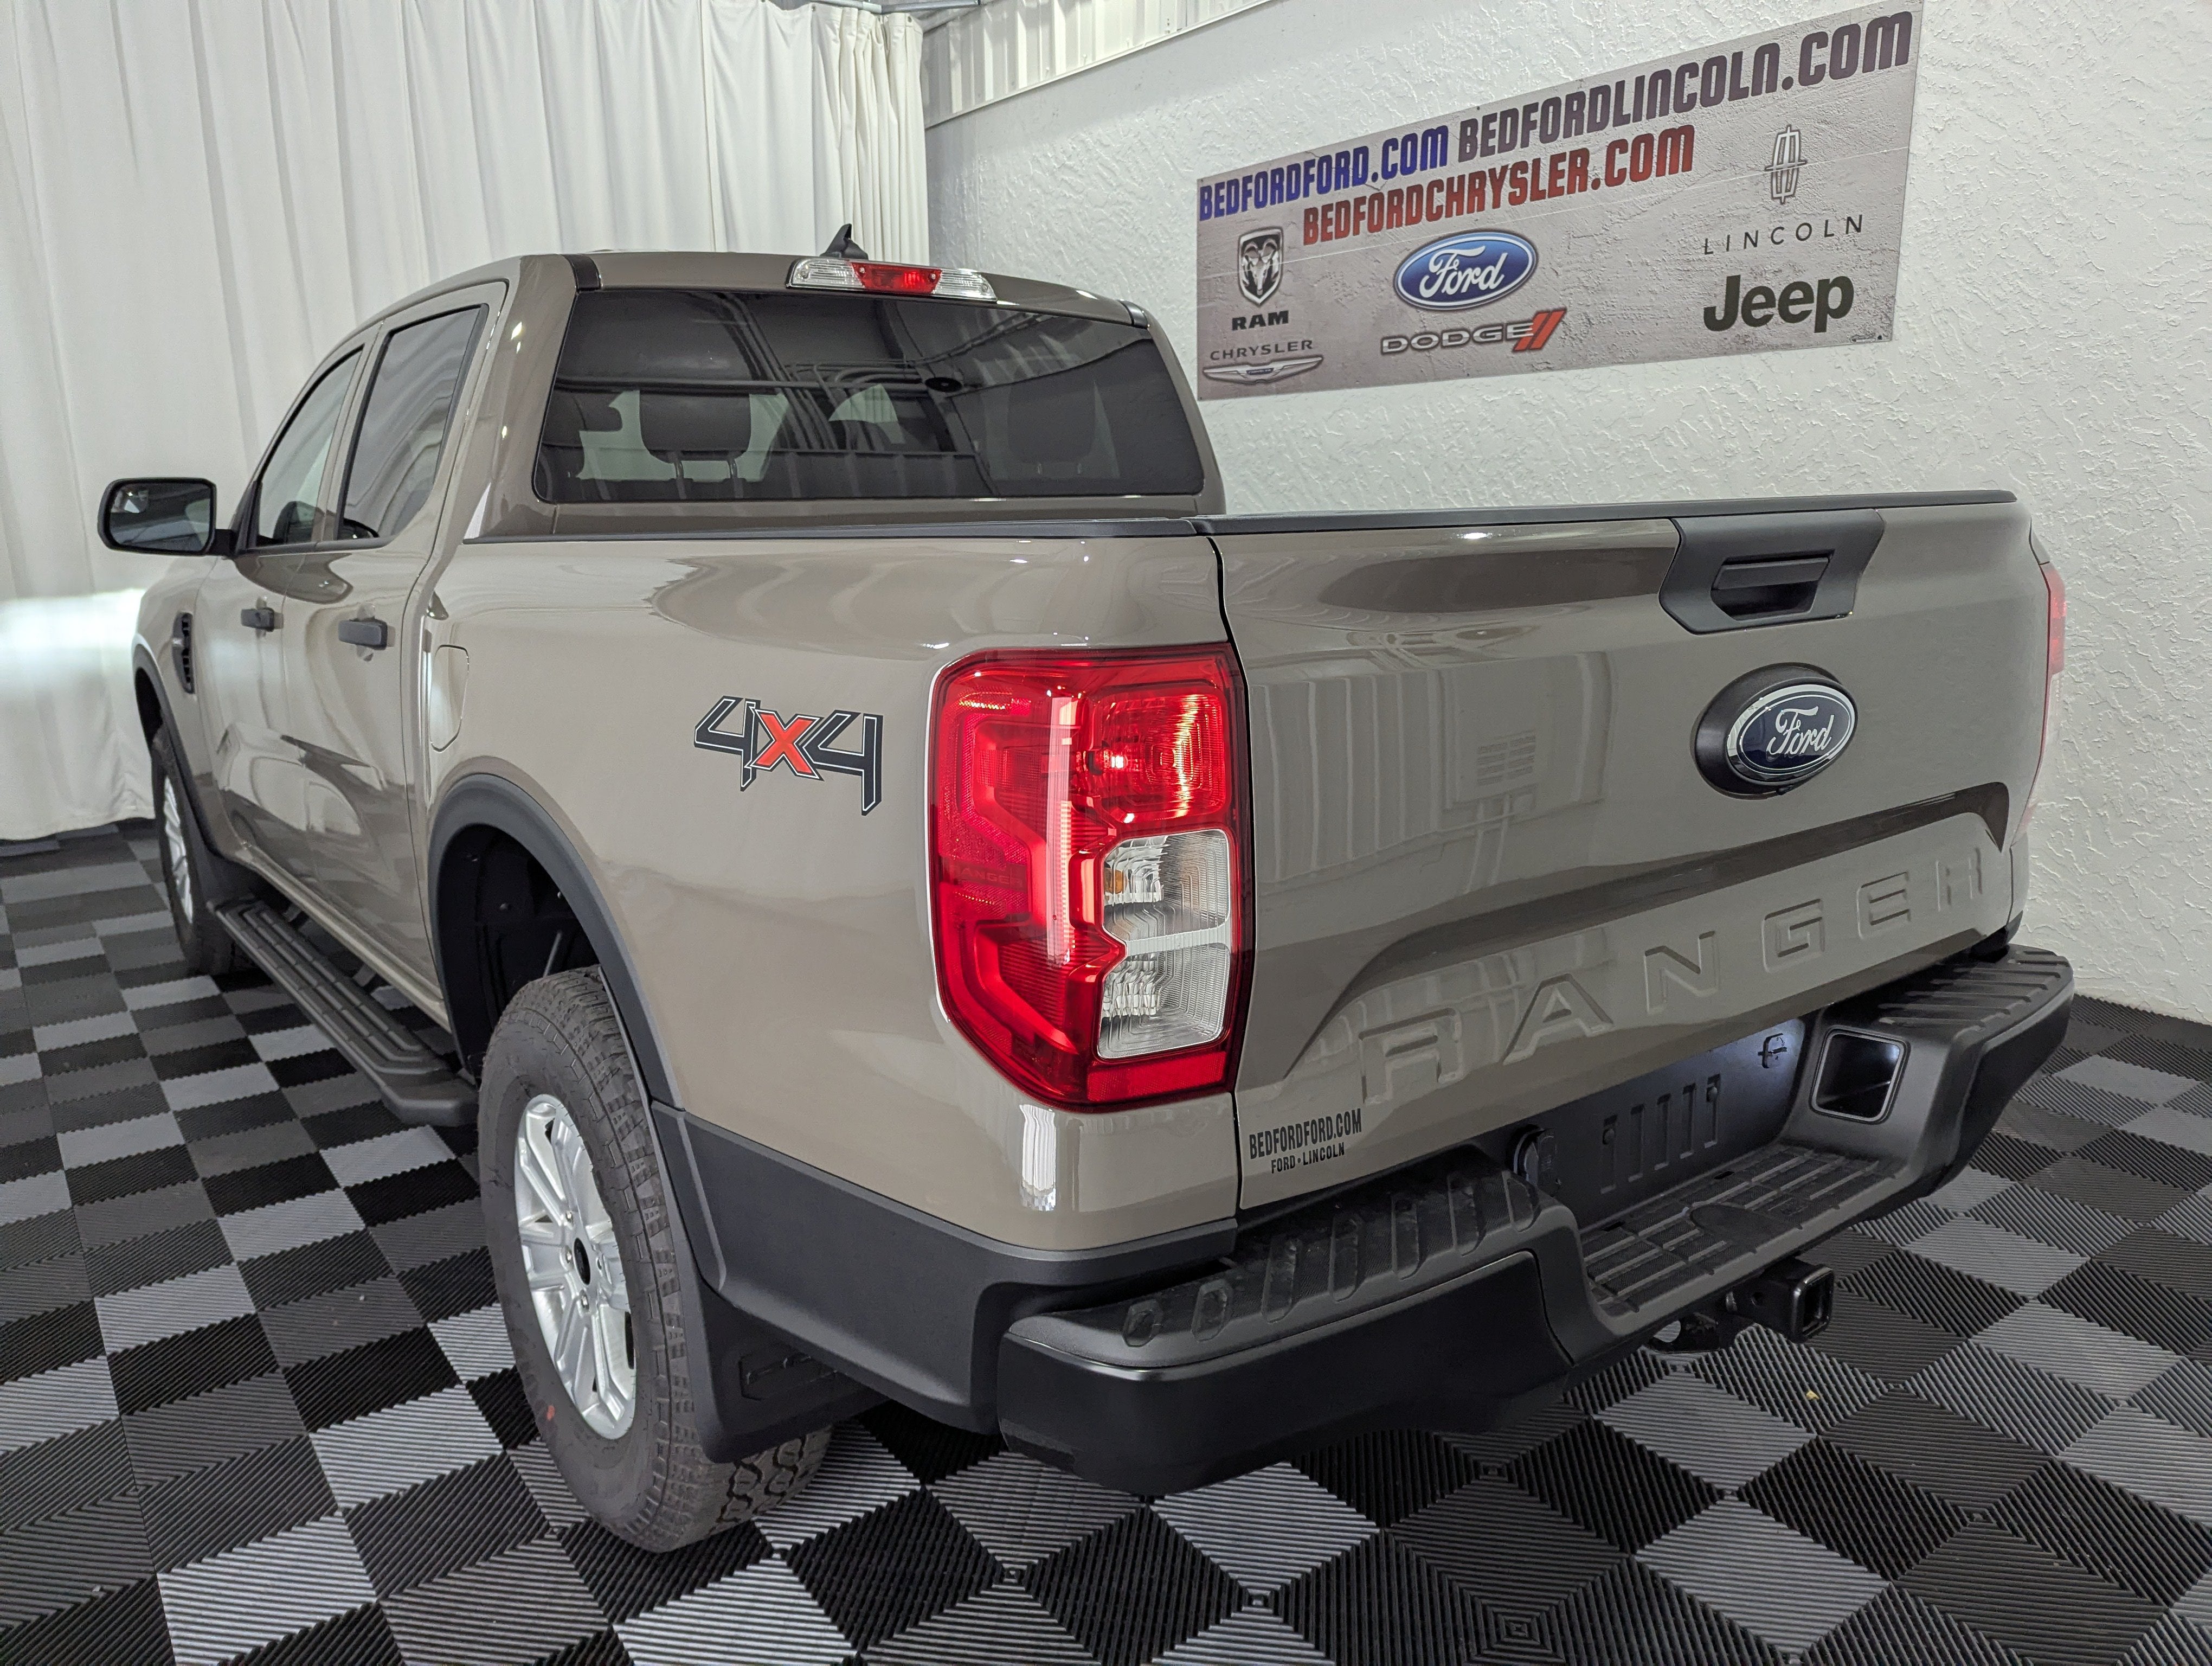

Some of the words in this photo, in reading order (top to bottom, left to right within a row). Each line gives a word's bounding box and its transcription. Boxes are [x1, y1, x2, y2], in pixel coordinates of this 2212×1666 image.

[1200, 125, 1448, 221] BEDFORDFORD.COM
[1458, 11, 1912, 163] BEDFORDLINCOLN.COM
[1303, 125, 1695, 246] BEDFORDCHRYSLER.COM
[1704, 214, 1863, 255] LINCOLN
[1419, 246, 1508, 298] Ford
[1232, 310, 1289, 331] RAM
[1703, 274, 1854, 333] Jeep
[1210, 340, 1313, 360] CHRYSLER
[1381, 320, 1534, 355] DODGE
[1766, 706, 1835, 761] Ford
[1358, 847, 1983, 1104] RANGER
[1249, 1108, 1362, 1159] BEDFORDFORD.COM
